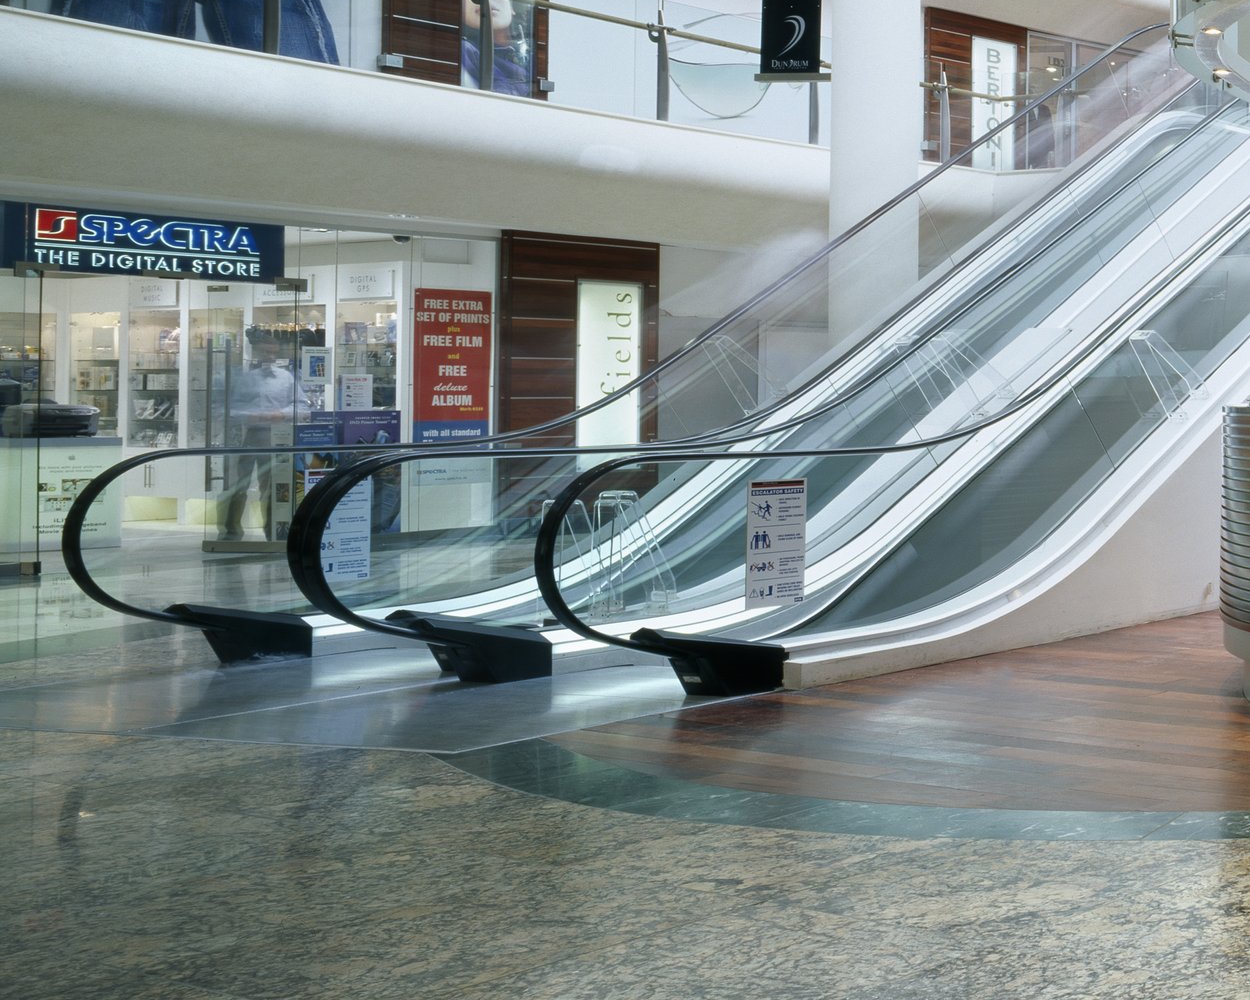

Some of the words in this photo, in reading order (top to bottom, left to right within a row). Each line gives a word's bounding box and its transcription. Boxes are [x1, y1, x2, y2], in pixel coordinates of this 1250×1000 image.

[79, 213, 260, 255] SPECTRA
[35, 249, 80, 266] THE
[91, 252, 182, 273] DIGITAL
[192, 260, 261, 277] STORE
[349, 275, 376, 284] DIGITAL
[423, 299, 450, 310] FREE
[452, 300, 484, 311] EXTRA
[416, 311, 436, 322] SET
[438, 312, 452, 323] OF
[454, 313, 490, 324] PRINTS
[423, 335, 453, 347] FREE
[455, 336, 483, 348] FILM
[438, 365, 467, 376] FREE
[433, 382, 468, 391] deluxe
[432, 394, 472, 406] ALBUM
[440, 429, 450, 437] all
[451, 428, 481, 437] standard
